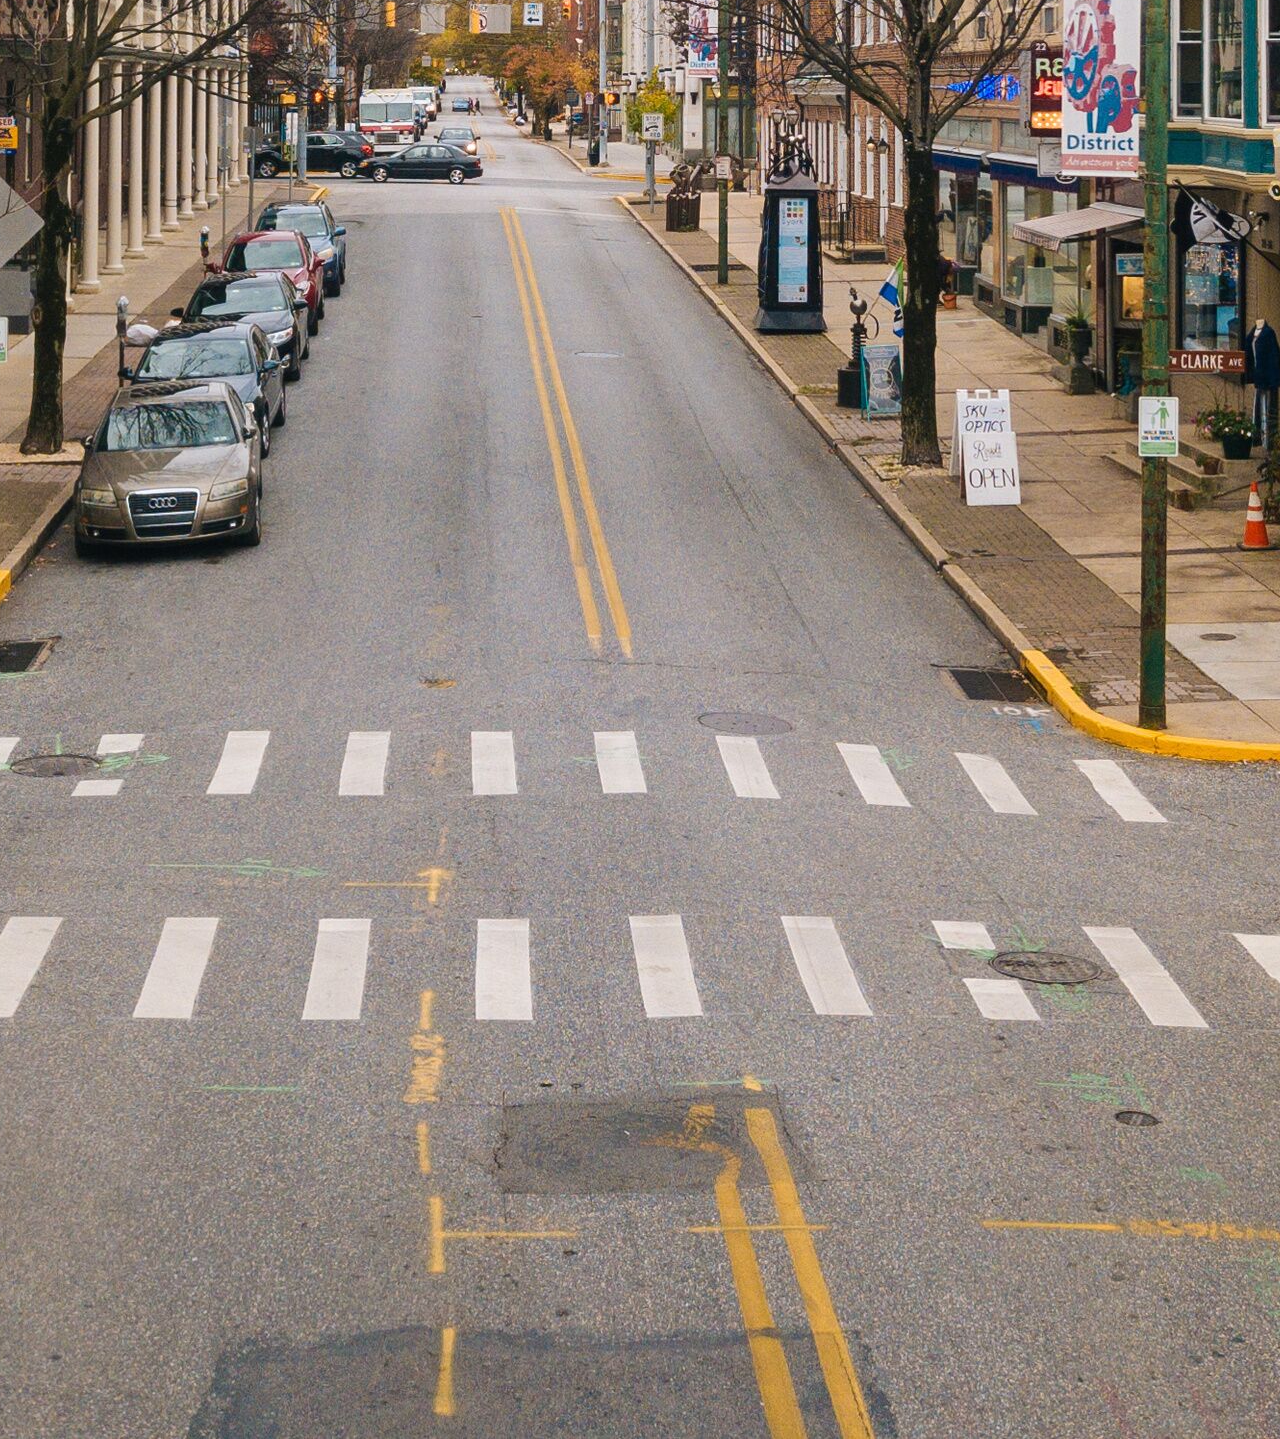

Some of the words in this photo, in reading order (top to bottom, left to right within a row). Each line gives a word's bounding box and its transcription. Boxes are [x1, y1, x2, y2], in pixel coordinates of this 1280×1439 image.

[1035, 42, 1047, 51] 22
[1066, 134, 1135, 151] District
[1180, 354, 1224, 370] CLARKE
[1228, 358, 1243, 367] AVE
[965, 420, 1007, 433] OPTICS
[969, 467, 1017, 489] OPEN
